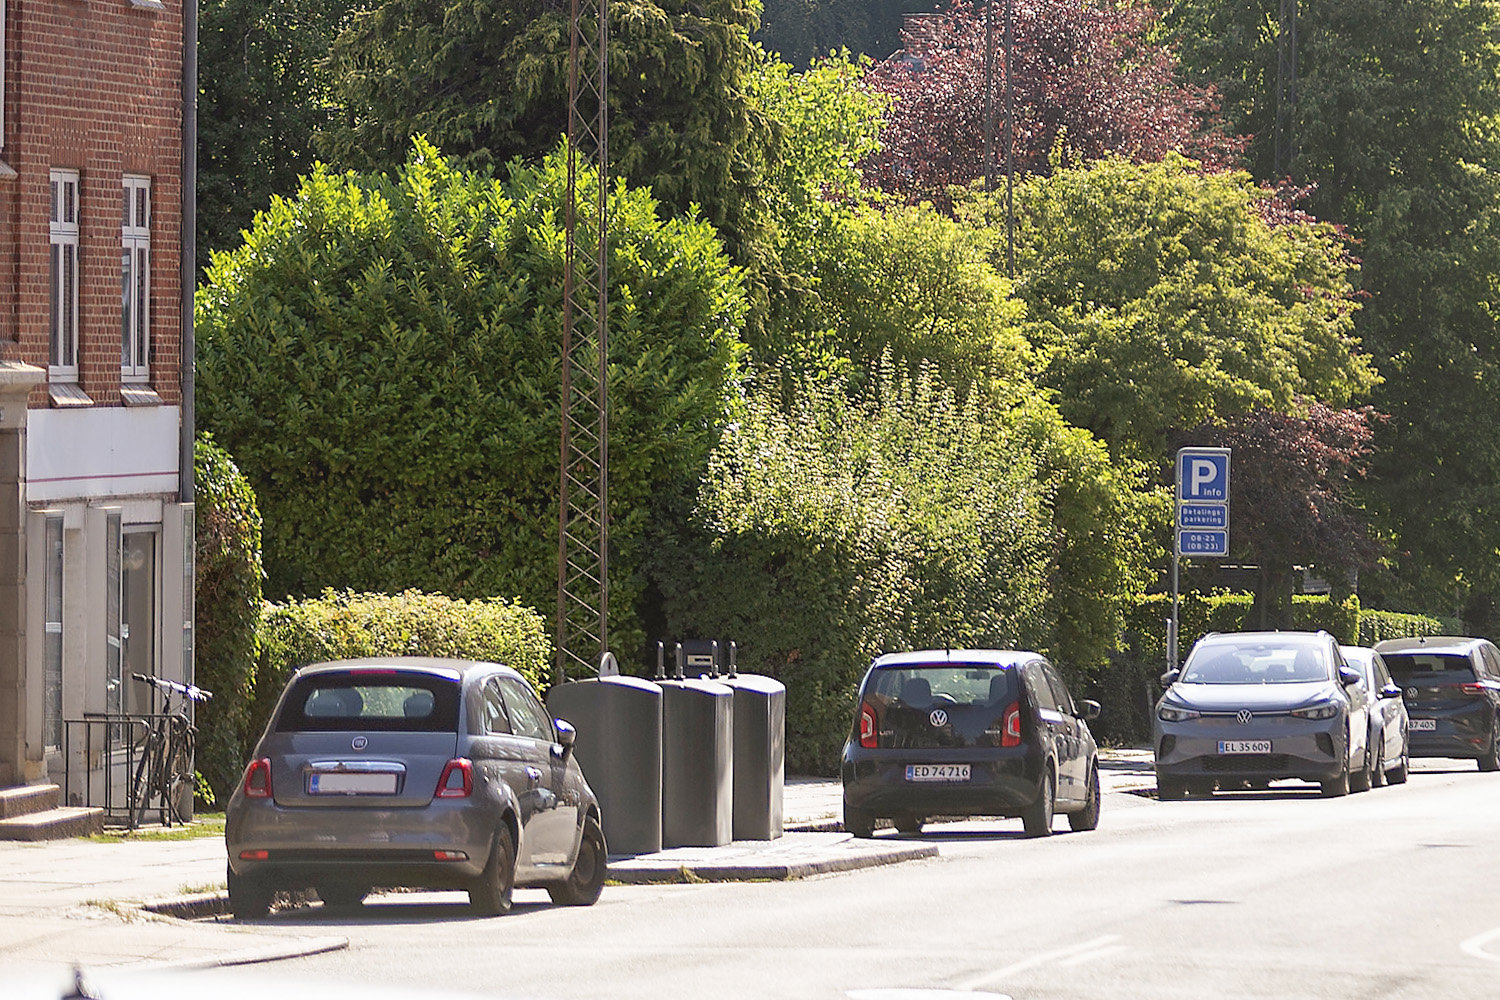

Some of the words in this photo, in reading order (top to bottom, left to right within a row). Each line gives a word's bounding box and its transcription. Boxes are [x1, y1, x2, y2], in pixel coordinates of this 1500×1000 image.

[1191, 459, 1218, 496] P
[1203, 487, 1222, 497] info
[1184, 516, 1222, 524] parkering
[1409, 721, 1418, 729] 87
[1420, 721, 1434, 729] 405
[1225, 743, 1236, 751] EL
[1239, 743, 1250, 751] 35
[1252, 743, 1269, 751] 609
[914, 767, 929, 777] ED
[932, 767, 945, 777] 74
[948, 767, 969, 777] 716
